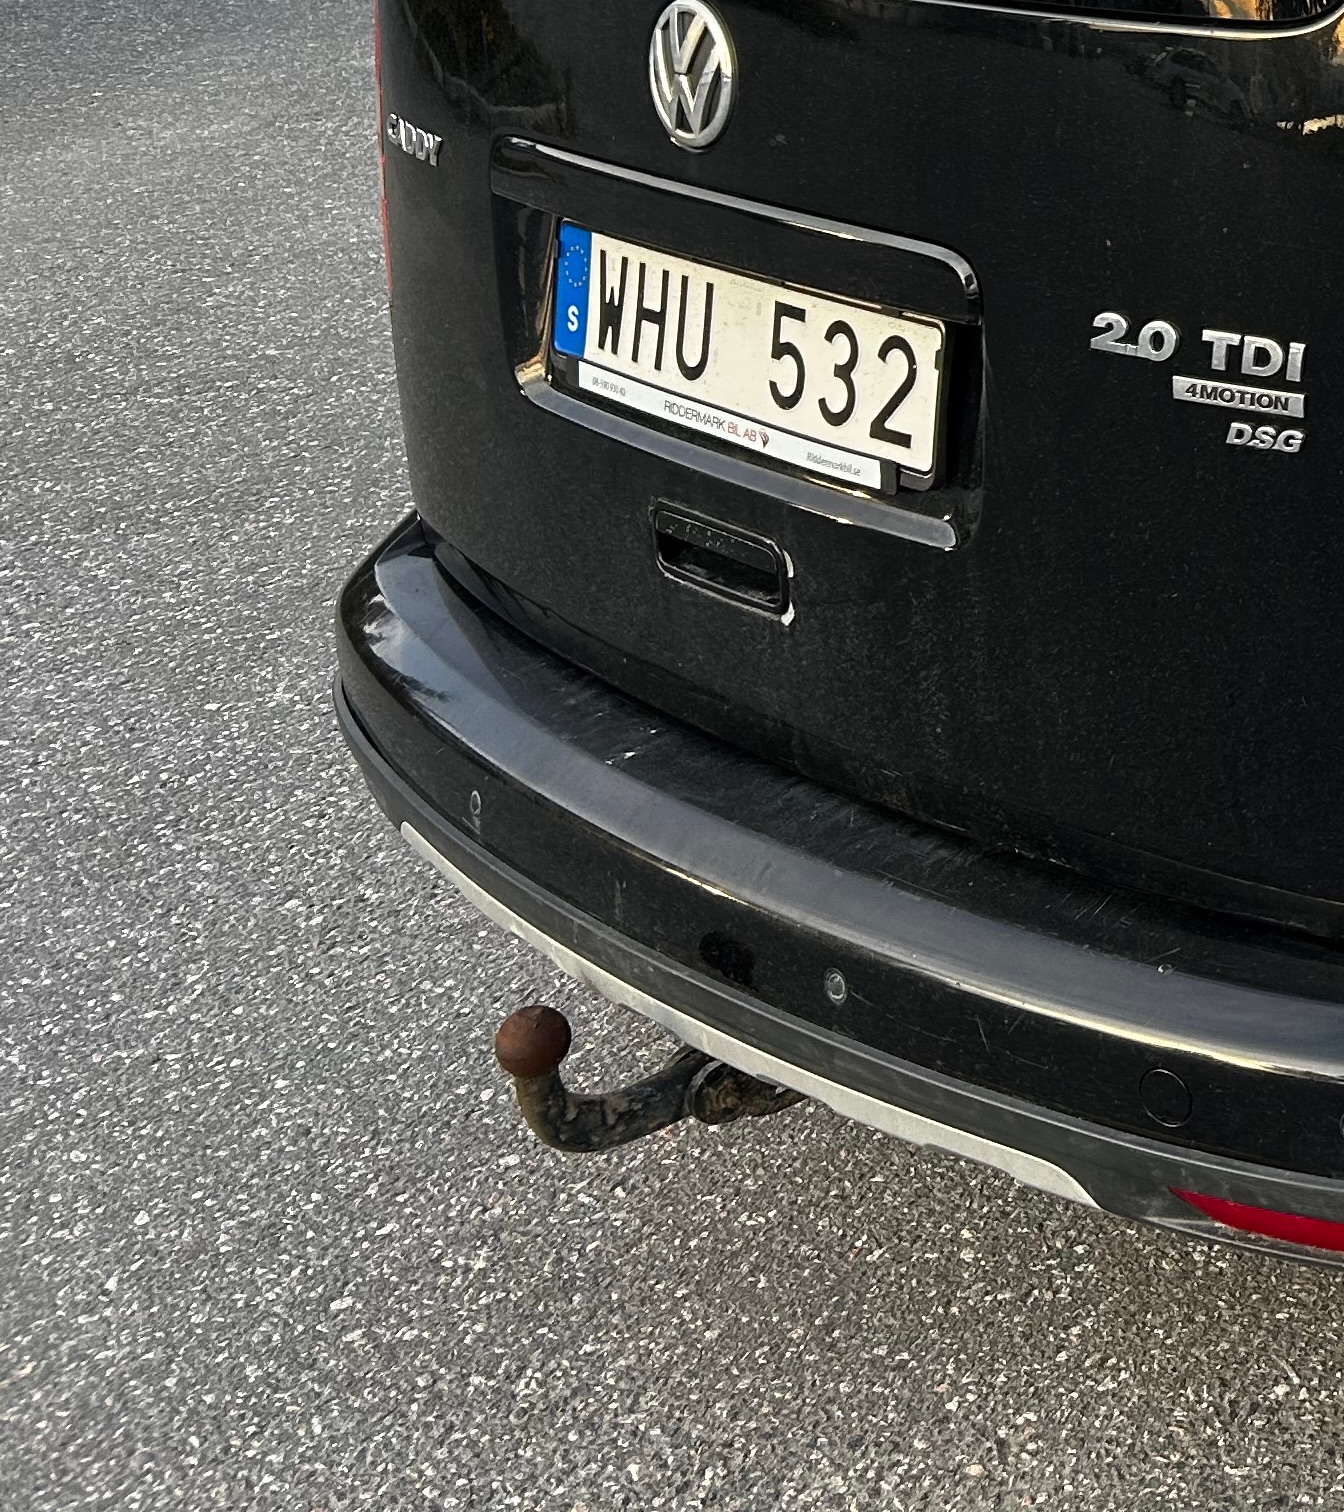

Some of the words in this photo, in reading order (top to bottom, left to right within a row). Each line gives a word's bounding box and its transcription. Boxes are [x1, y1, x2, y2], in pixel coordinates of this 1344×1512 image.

[567, 305, 579, 332] S
[598, 249, 714, 381] WHU
[769, 300, 918, 449] 532
[1201, 329, 1306, 382] TDI
[1184, 383, 1290, 411] 4MOTION
[664, 399, 727, 432] RIDDERMARK
[743, 427, 757, 442] AB
[1225, 421, 1306, 453] DSG
